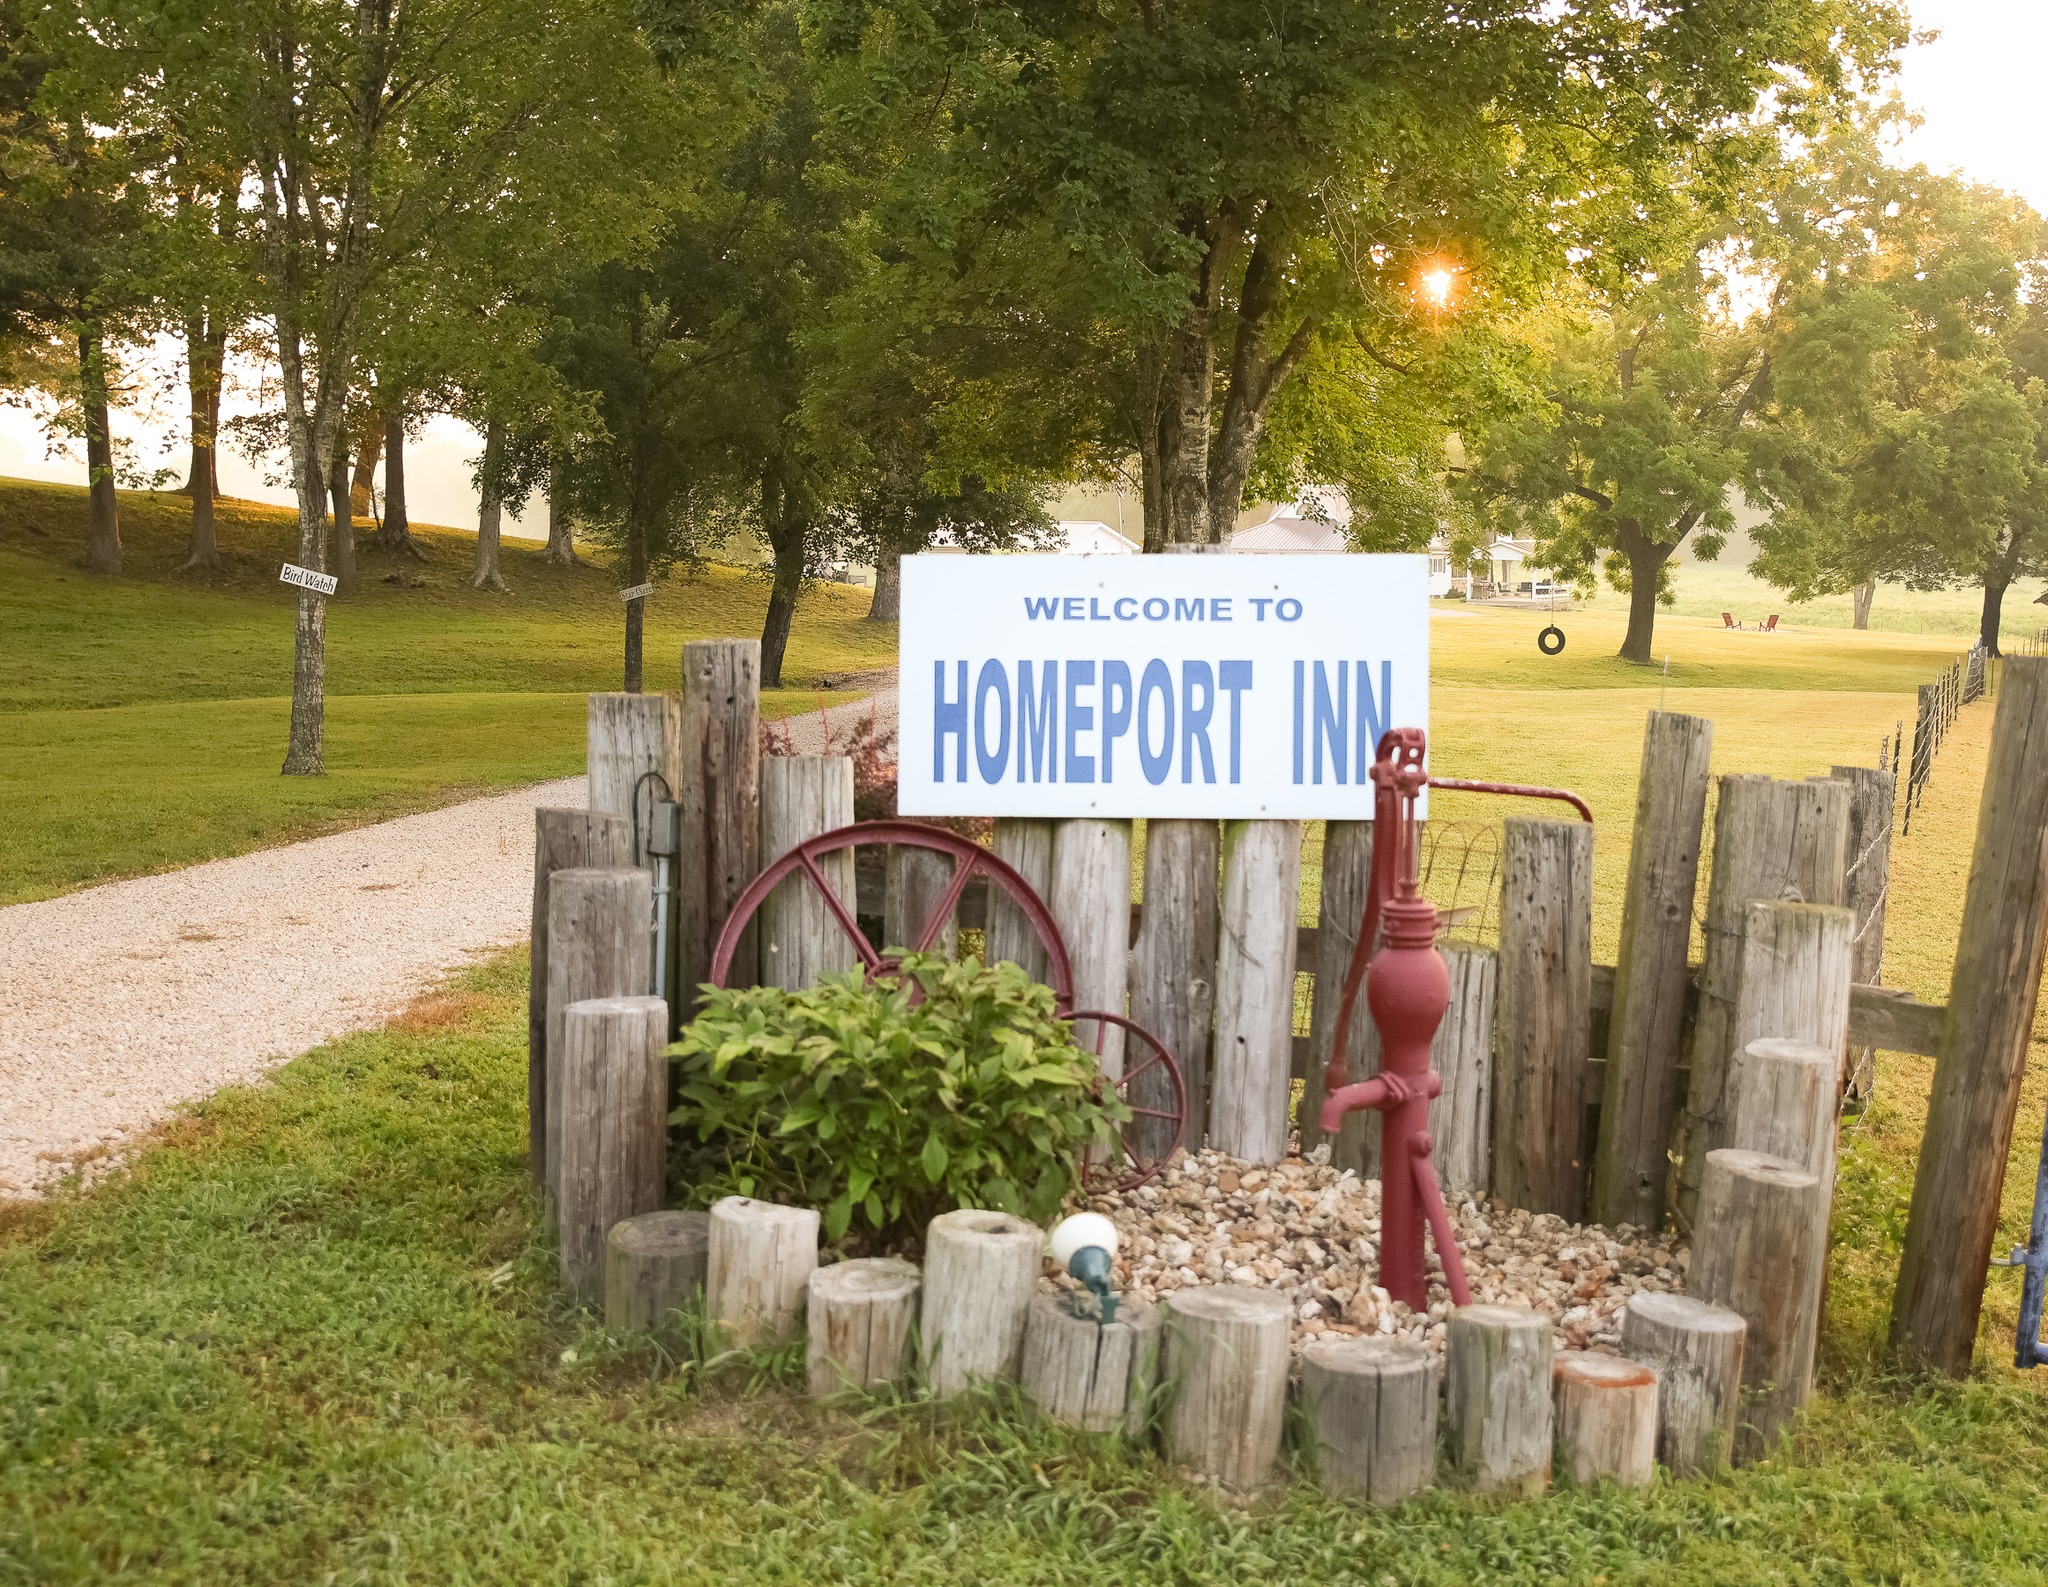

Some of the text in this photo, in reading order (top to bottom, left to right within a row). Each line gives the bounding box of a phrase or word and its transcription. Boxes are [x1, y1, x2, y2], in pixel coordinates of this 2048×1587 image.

[283, 567, 334, 592] Bird Watch
[1024, 597, 1304, 622] WELCOME TO
[933, 658, 1392, 786] HOMEPORT INN
